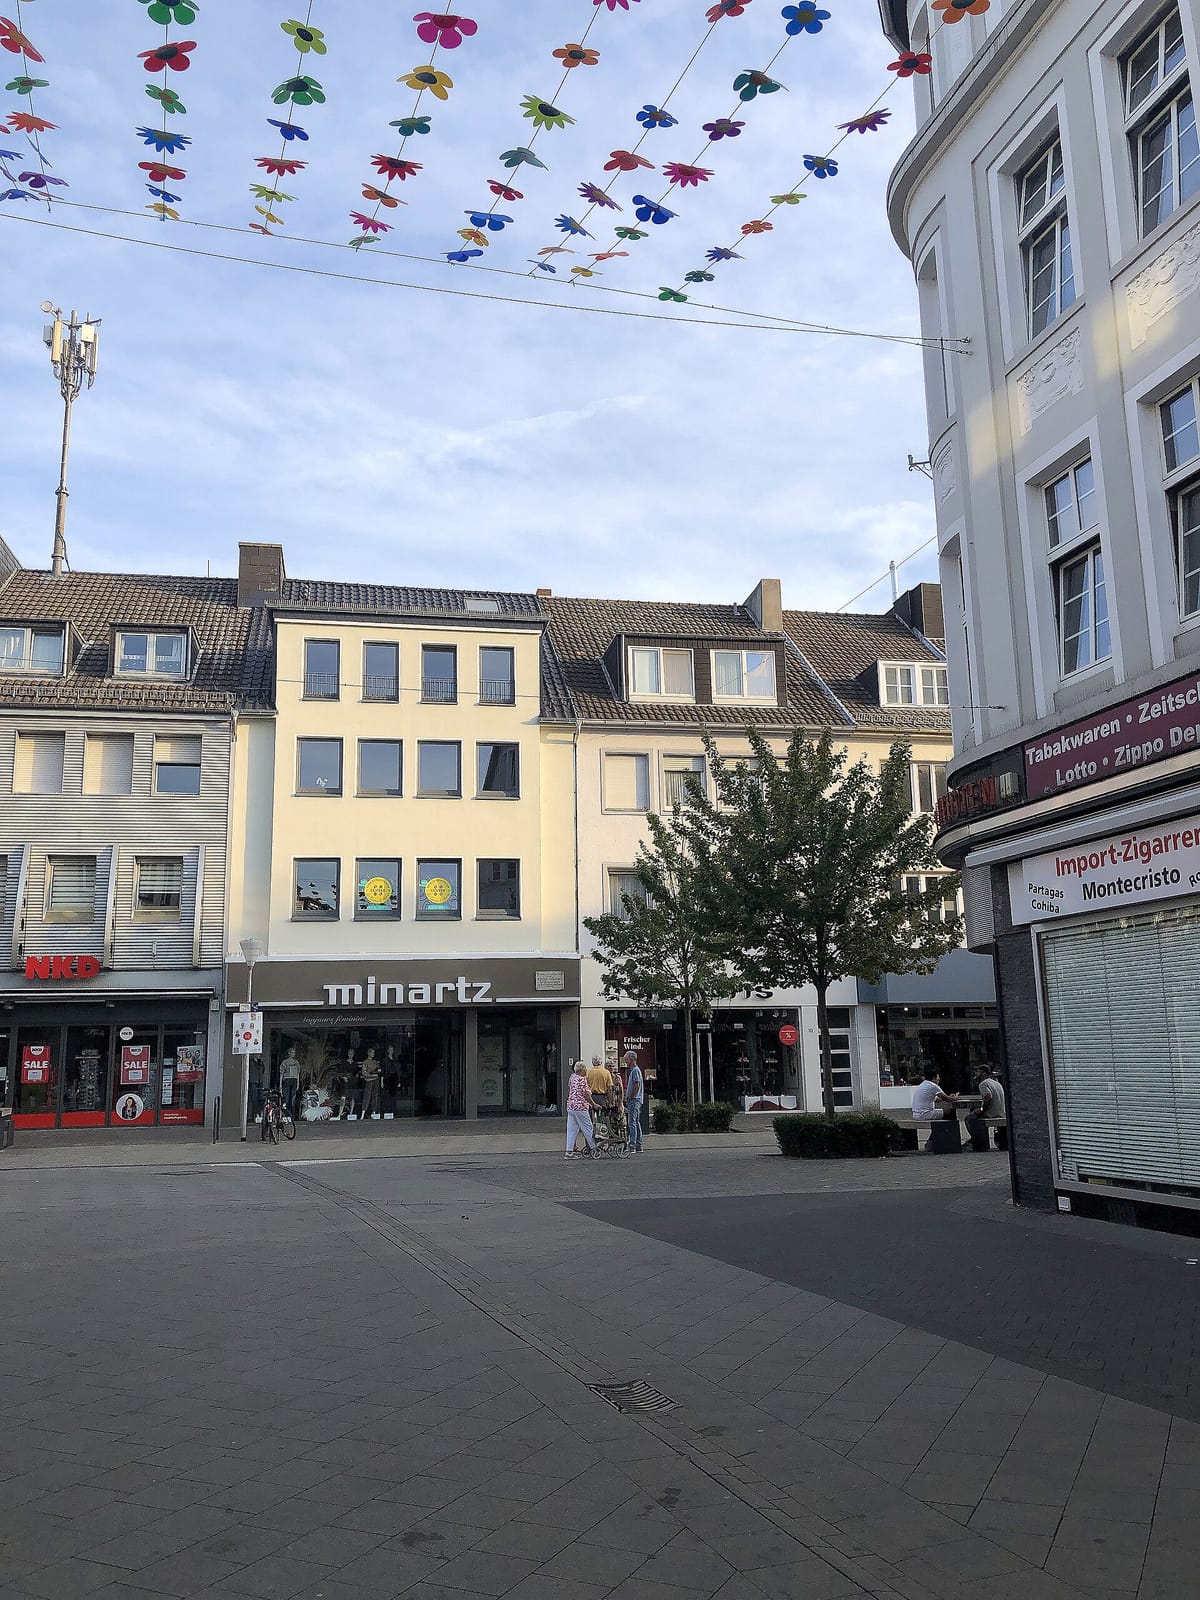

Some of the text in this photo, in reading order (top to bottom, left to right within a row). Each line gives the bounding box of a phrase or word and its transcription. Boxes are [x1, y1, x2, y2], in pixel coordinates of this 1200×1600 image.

[1026, 718, 1121, 765] Tabakwaren
[1056, 760, 1097, 786] Lotto
[1114, 737, 1164, 766] Zippo
[1028, 883, 1064, 899] Partagas
[1082, 867, 1180, 900] Montecristo
[1031, 899, 1060, 913] Cohiba
[25, 956, 100, 979] NKD
[323, 976, 492, 1005] minartz
[23, 1060, 49, 1069] SALE
[123, 1060, 148, 1069] SALE
